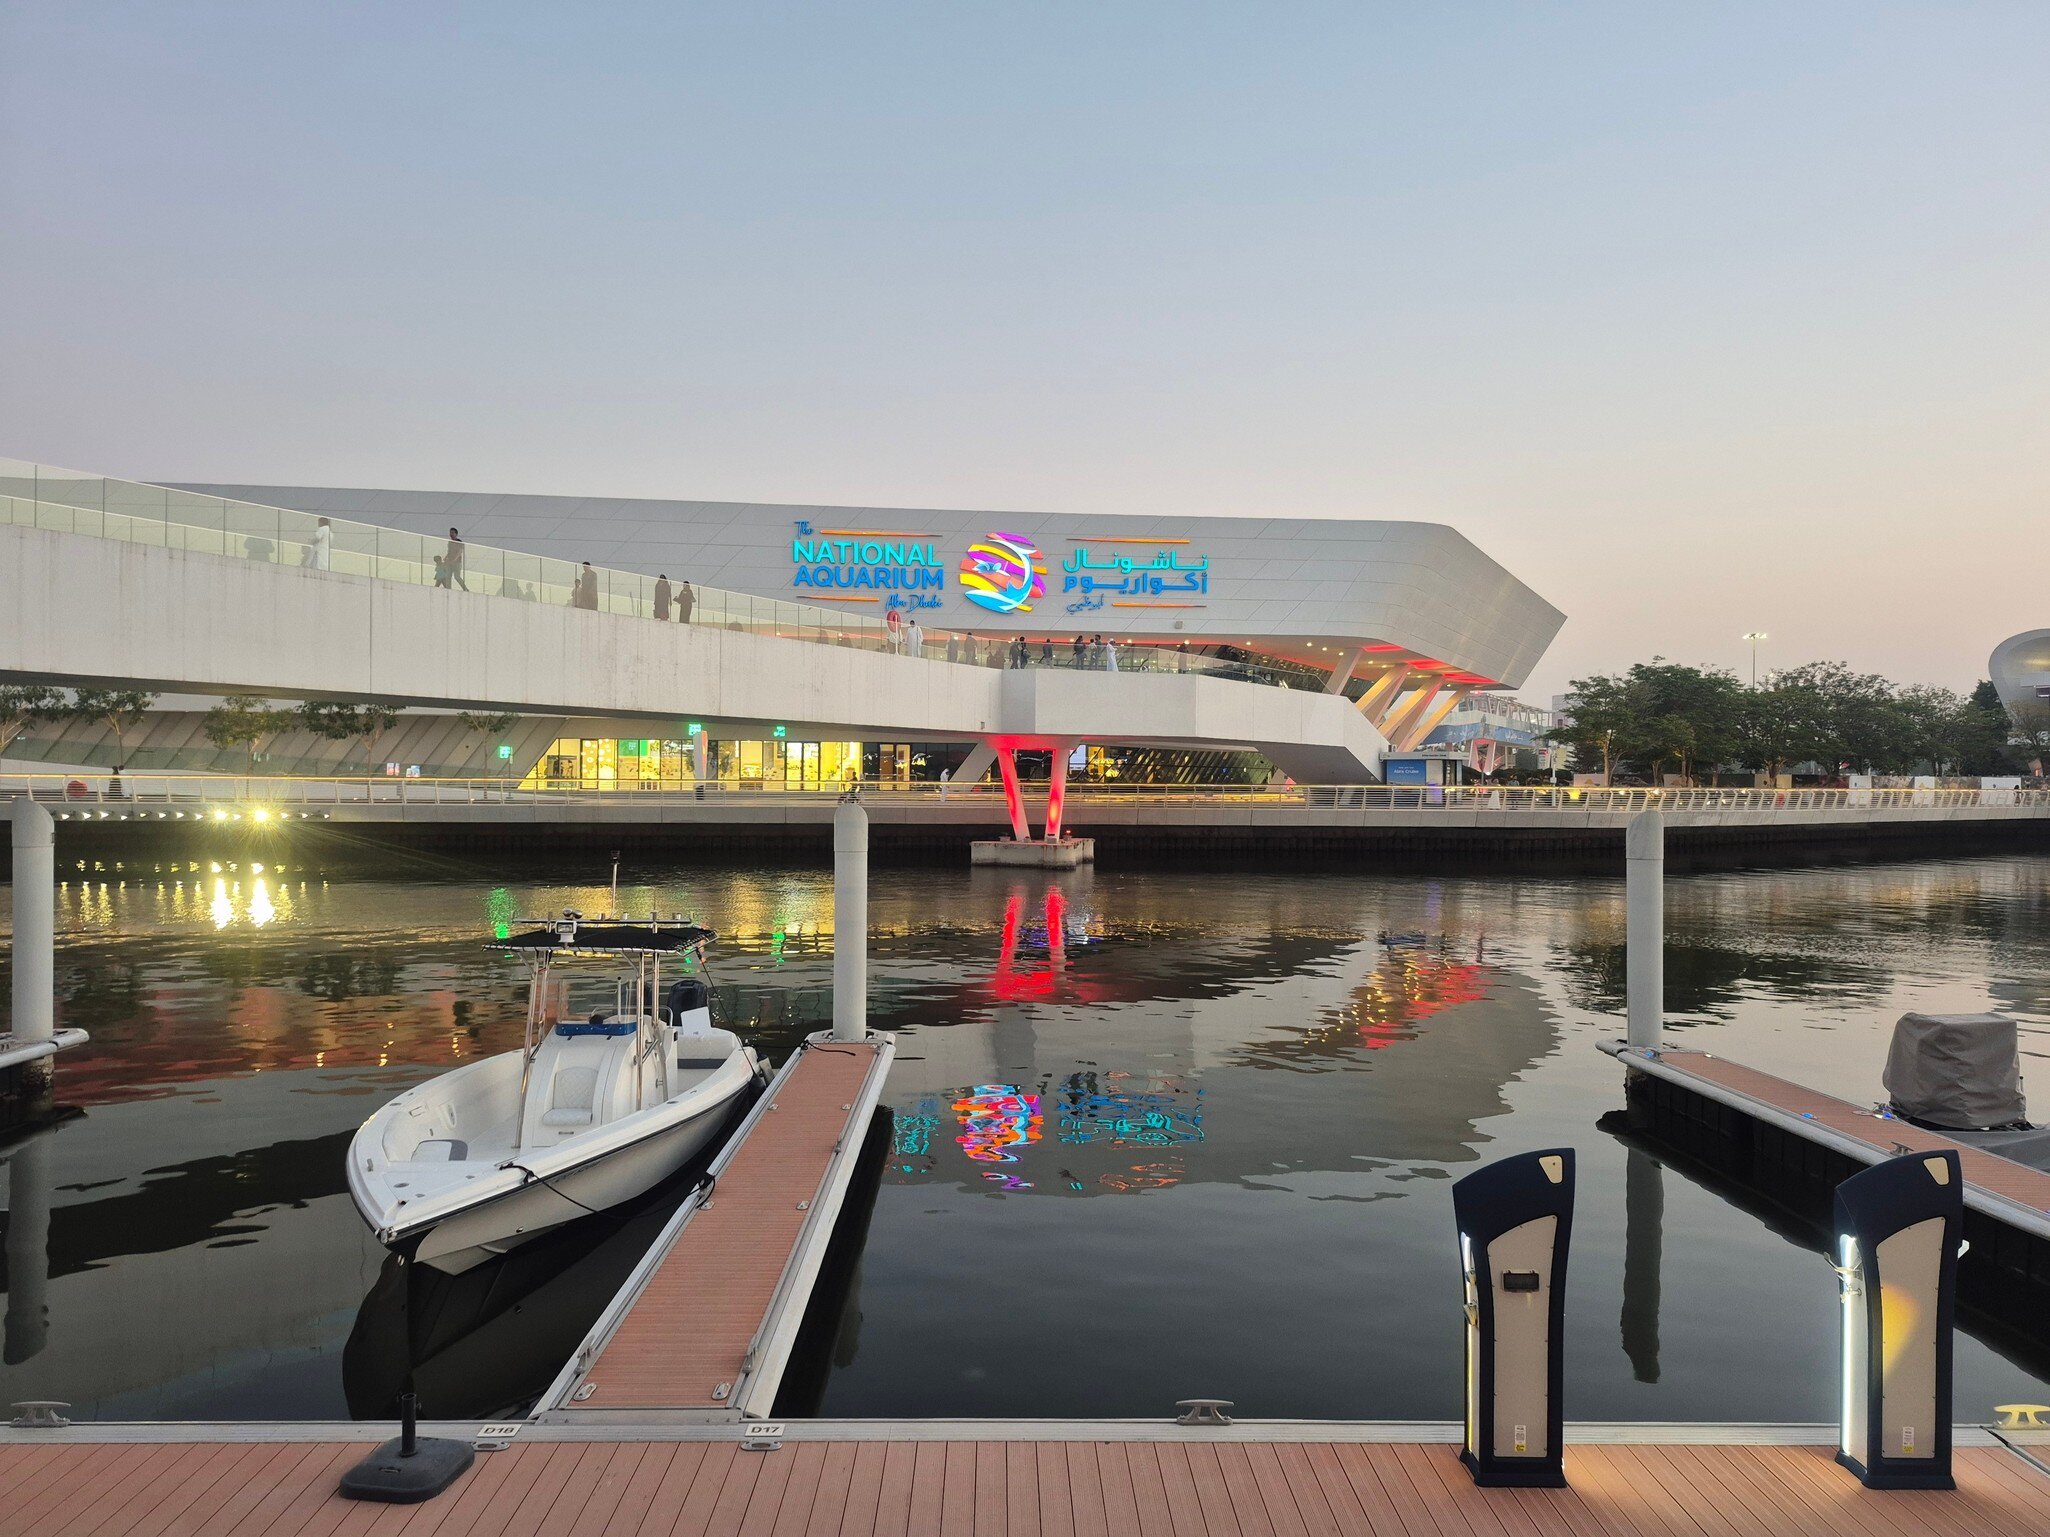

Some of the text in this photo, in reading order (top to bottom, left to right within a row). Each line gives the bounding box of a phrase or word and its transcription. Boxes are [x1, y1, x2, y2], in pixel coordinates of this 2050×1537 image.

[794, 520, 813, 539] The
[792, 540, 945, 567] NATIONAL
[1062, 548, 1209, 574] ناشونال
[793, 565, 945, 590] AQUARIUM
[1062, 571, 1209, 595] أكواريوم
[885, 593, 943, 613] Abu Dhabi
